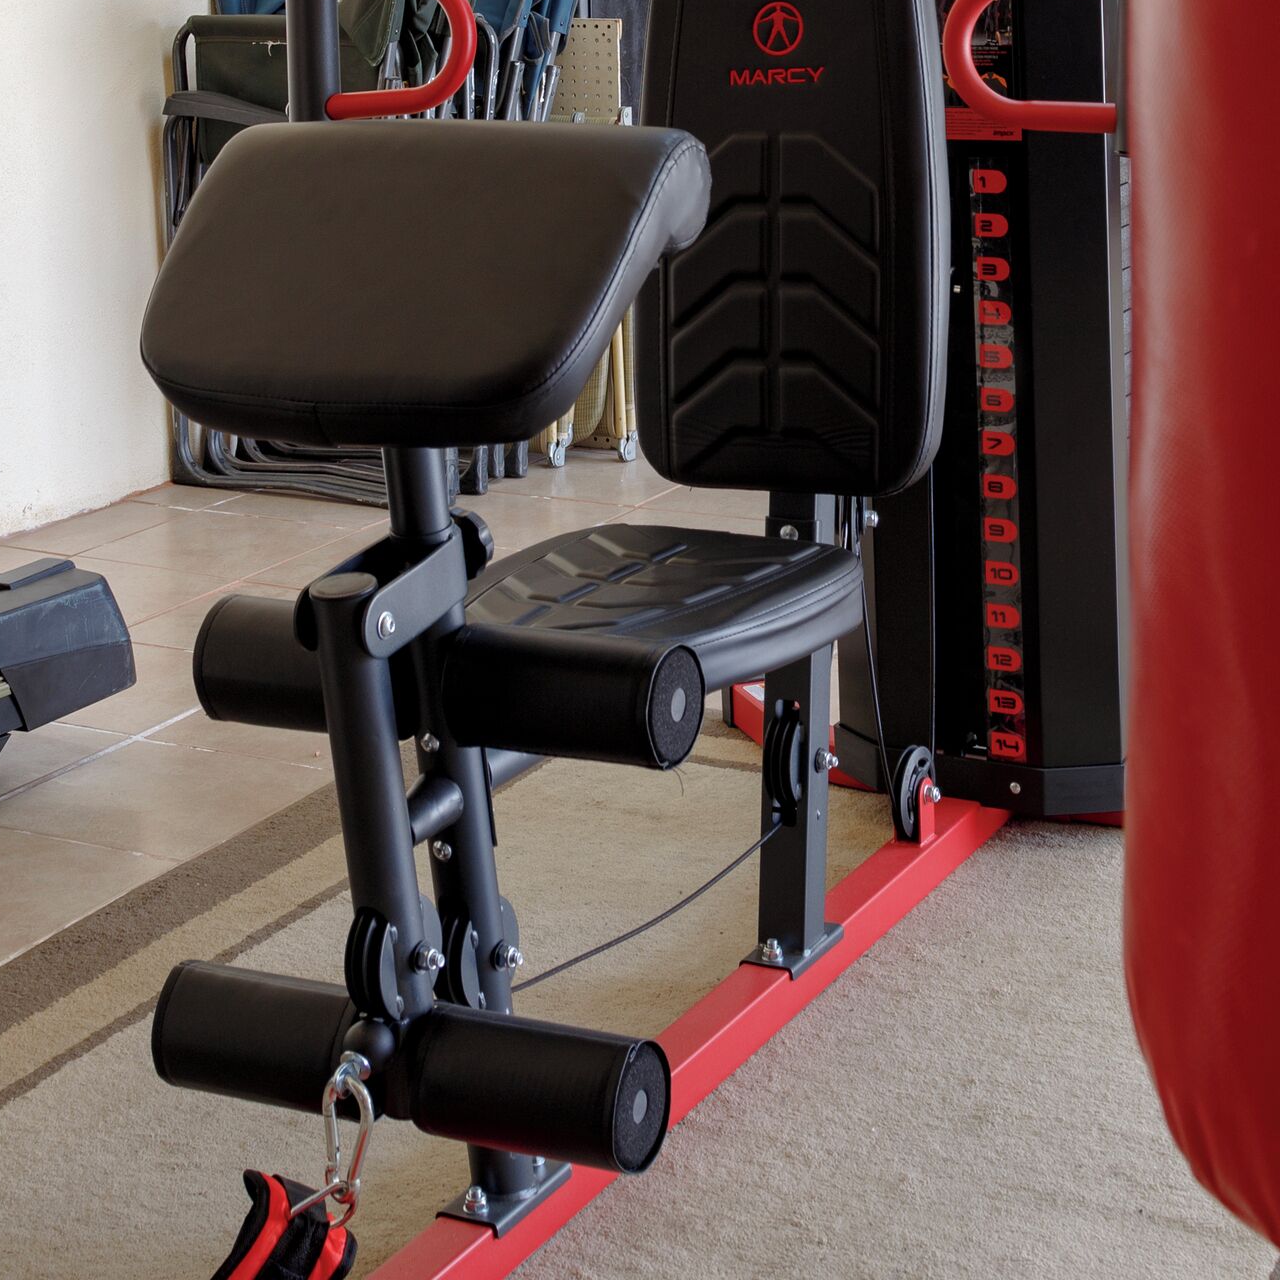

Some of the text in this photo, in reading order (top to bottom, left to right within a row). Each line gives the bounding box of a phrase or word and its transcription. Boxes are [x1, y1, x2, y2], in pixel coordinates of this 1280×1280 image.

[729, 66, 825, 87] MARCY
[978, 177, 987, 188] 1
[980, 220, 993, 232] 2
[982, 264, 997, 276] 3
[983, 307, 1000, 319] 4
[984, 351, 1000, 363] 5
[985, 395, 1001, 407] 6
[986, 438, 1002, 449] 7
[987, 481, 1004, 493] 8
[988, 524, 1005, 537] 9
[990, 567, 1012, 580] 10
[991, 610, 1007, 623] 11
[993, 653, 1012, 666] 12
[994, 697, 1017, 709] 13
[995, 739, 1019, 752] 14
